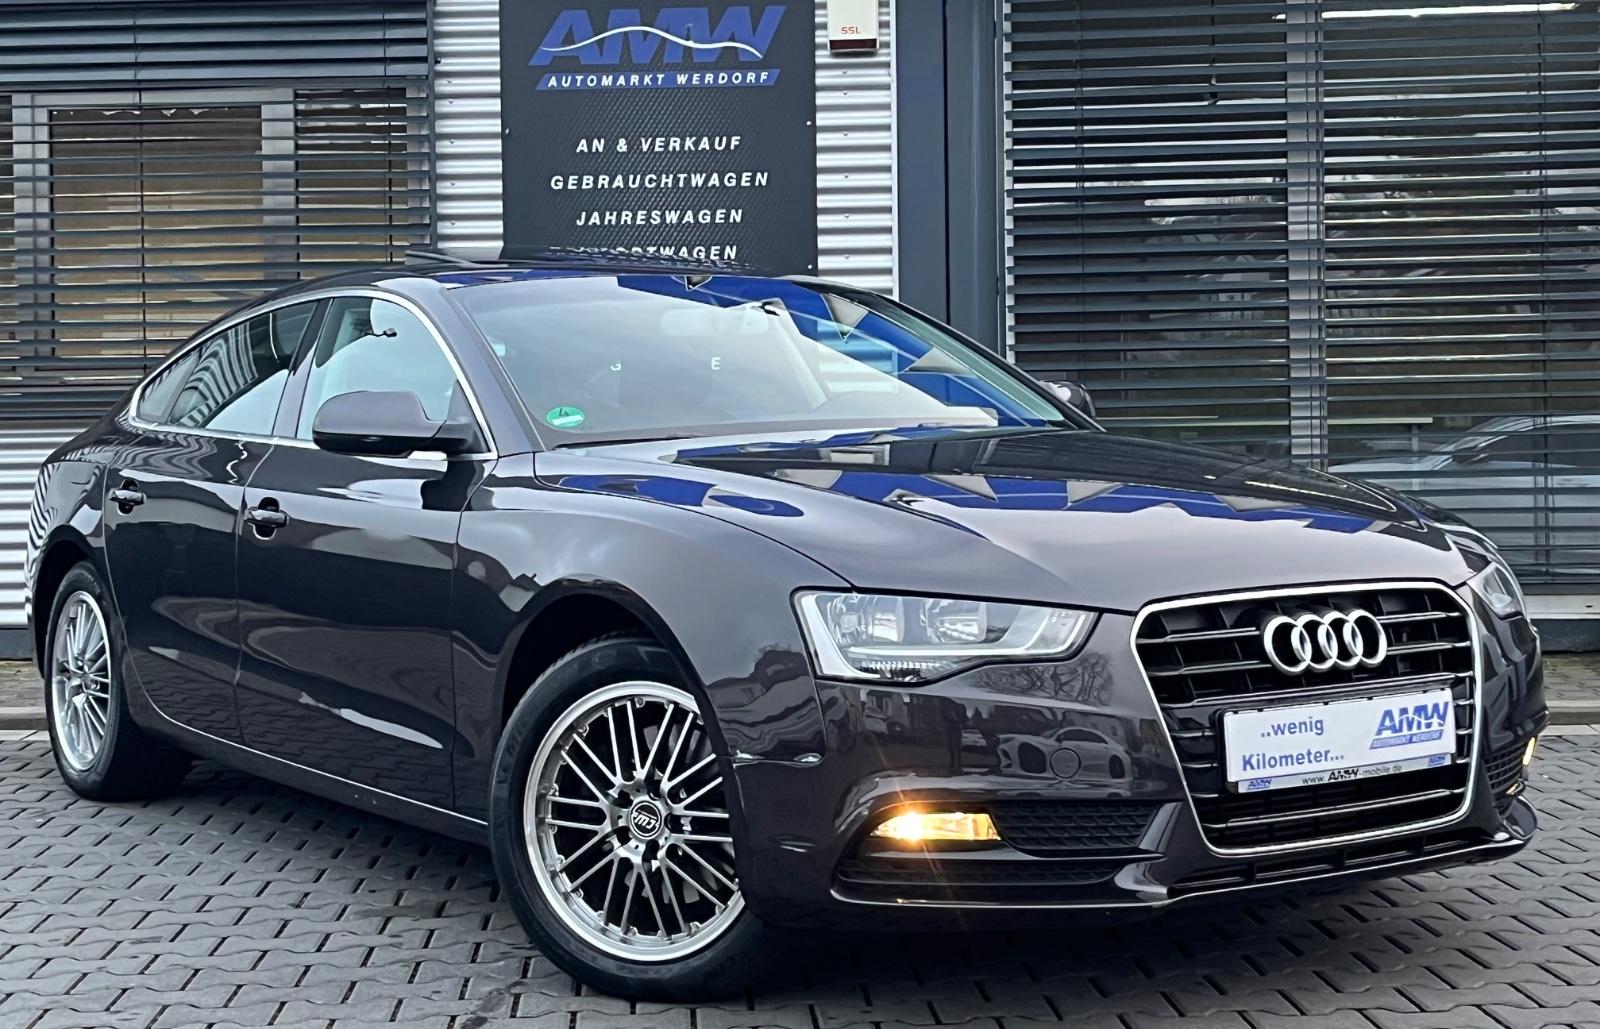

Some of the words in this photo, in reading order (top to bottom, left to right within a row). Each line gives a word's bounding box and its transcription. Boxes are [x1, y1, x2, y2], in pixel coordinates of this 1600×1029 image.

[528, 5, 787, 66] AMW
[841, 26, 861, 34] SSL
[547, 74, 665, 88] AUTOMARKT
[676, 71, 770, 86] WERDORF
[576, 138, 605, 153] AN
[616, 138, 628, 153] &
[641, 136, 742, 152] VERKAUF
[550, 172, 769, 190] GEBRAUCHTWAGEN
[576, 209, 743, 226] JAHRESWAGEN
[1375, 701, 1449, 737] AMW
